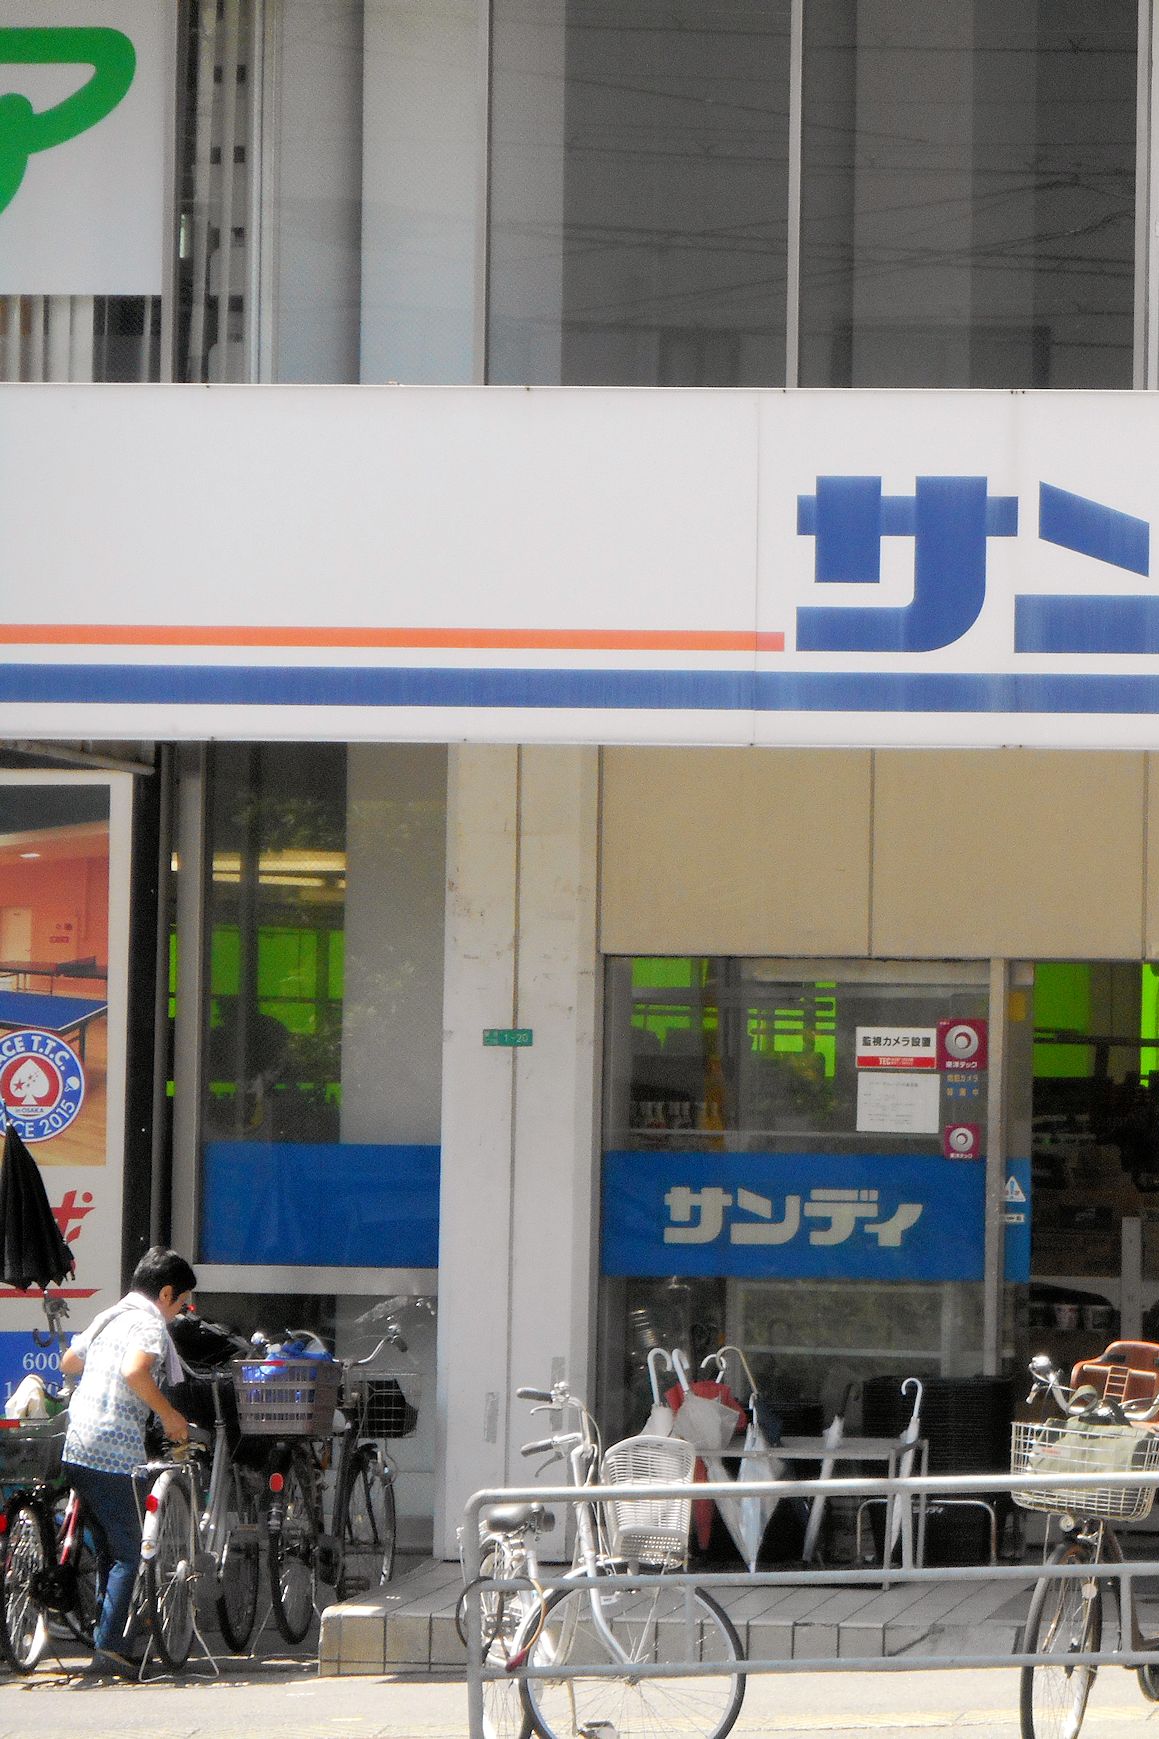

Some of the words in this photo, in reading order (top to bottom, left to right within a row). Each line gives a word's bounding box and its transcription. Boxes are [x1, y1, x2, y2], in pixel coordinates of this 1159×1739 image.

[31, 1035, 70, 1071] T.T.C.
[862, 1036, 931, 1047] 監視カメラ設置
[40, 1099, 75, 1135] 2015
[663, 1186, 923, 1247] サンディ
[22, 1352, 60, 1371] 600
